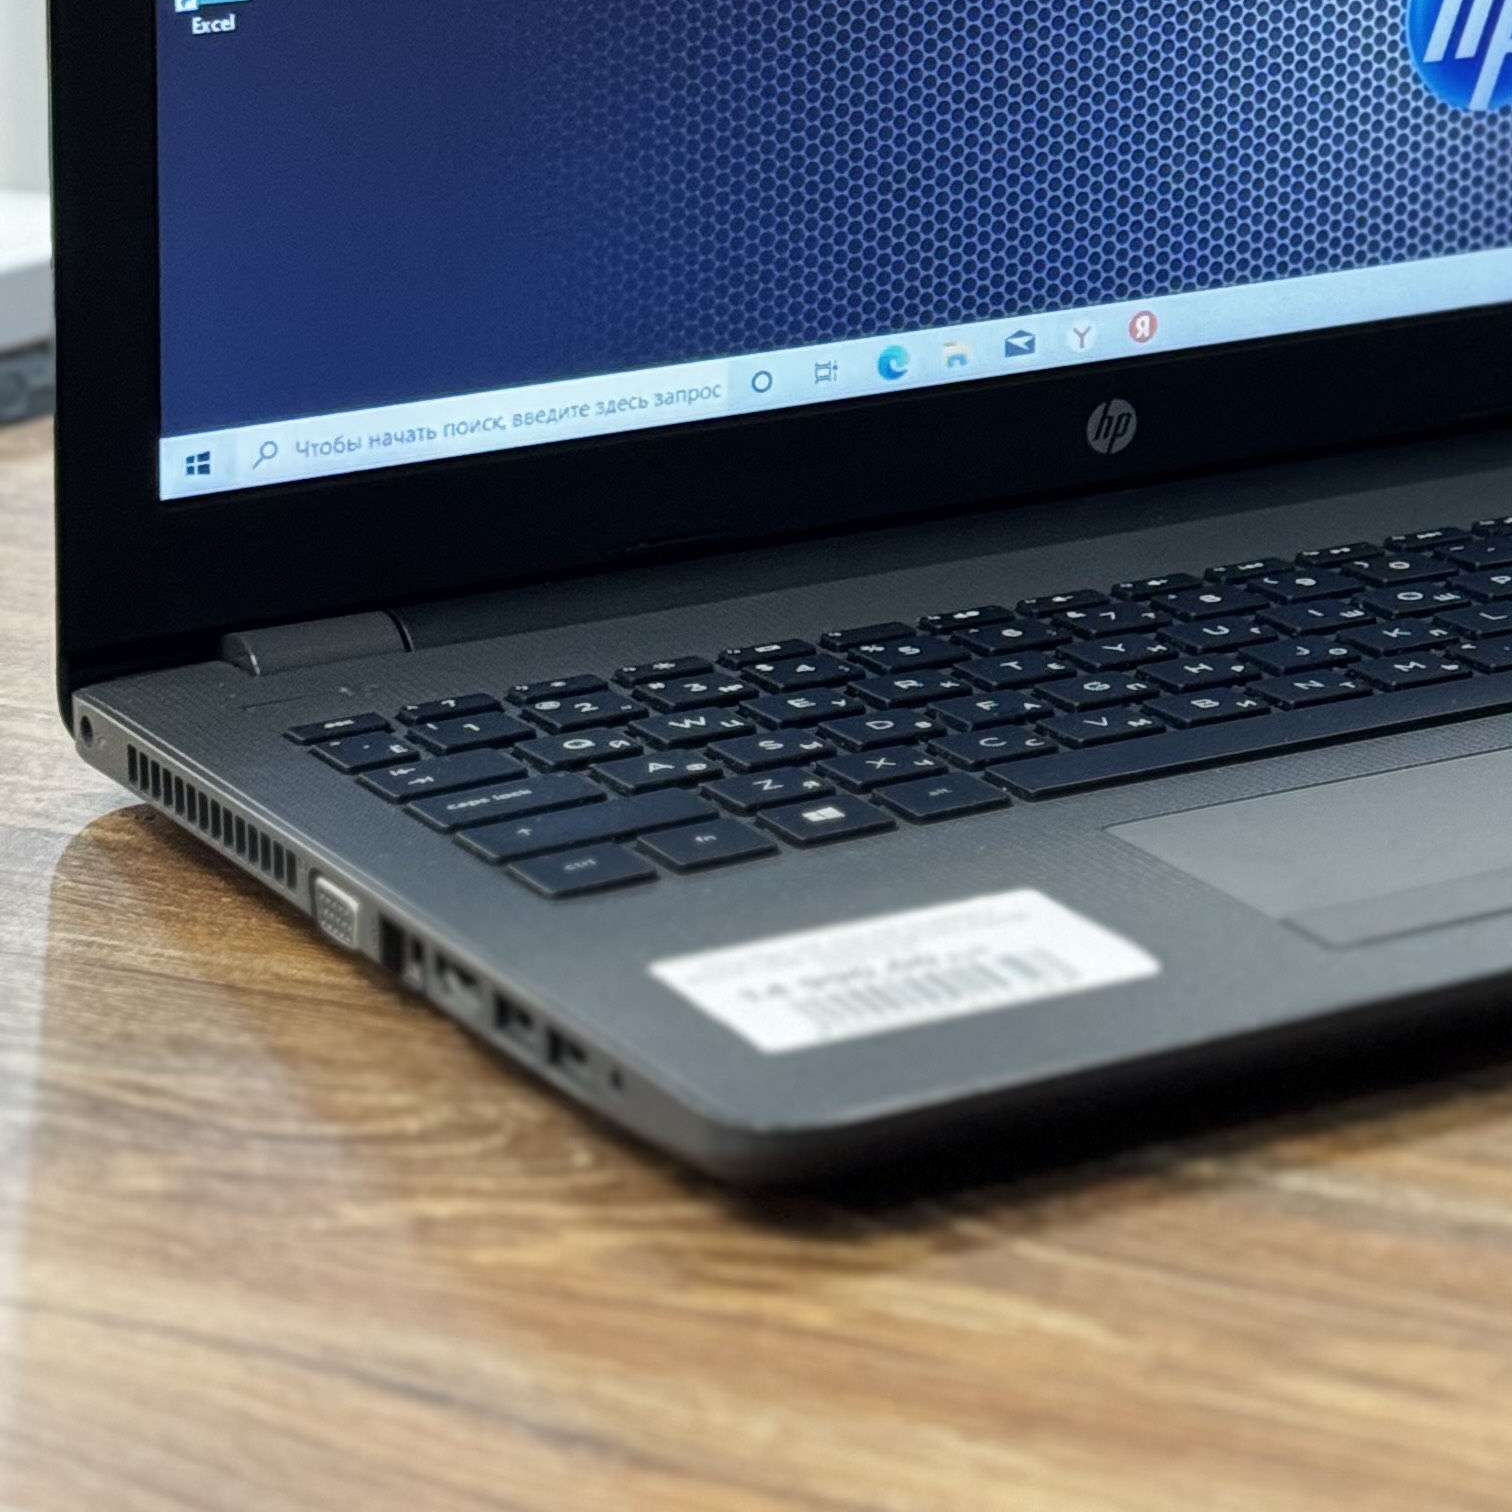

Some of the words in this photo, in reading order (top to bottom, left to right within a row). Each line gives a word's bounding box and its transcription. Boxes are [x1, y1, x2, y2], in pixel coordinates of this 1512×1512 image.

[191, 13, 236, 35] Excel
[295, 435, 363, 459] Чтобы
[369, 426, 438, 448] начать
[443, 413, 507, 438] поиск,
[512, 402, 590, 429] введите
[595, 393, 649, 417] здесь
[654, 381, 722, 408] запрос
[1092, 398, 1134, 454] hp
[1489, 575, 1512, 585] P
[1396, 591, 1424, 601] O
[1098, 611, 1116, 621] 7
[1479, 612, 1508, 621] L
[1201, 624, 1231, 636] U
[1382, 627, 1412, 638] K
[897, 645, 921, 656] 5
[1101, 642, 1126, 653] Y
[999, 660, 1023, 671] T
[1183, 662, 1214, 674] H
[1393, 660, 1427, 672] M
[682, 682, 708, 693] 3
[893, 679, 920, 690] R
[1082, 680, 1111, 692] G
[1292, 679, 1326, 690] N
[573, 701, 600, 713] 2
[786, 697, 817, 709] E
[975, 700, 999, 711] F
[1190, 698, 1220, 709] B
[667, 715, 707, 729] W
[865, 720, 895, 731] D
[1082, 716, 1109, 727] V
[562, 738, 597, 750] Q
[757, 739, 785, 751] S
[978, 736, 1007, 748] C
[648, 761, 675, 774] A
[865, 757, 897, 769] X
[752, 778, 785, 791] Z
[446, 797, 491, 811] caps
[490, 789, 533, 801] lock
[564, 858, 597, 872] ctrl
